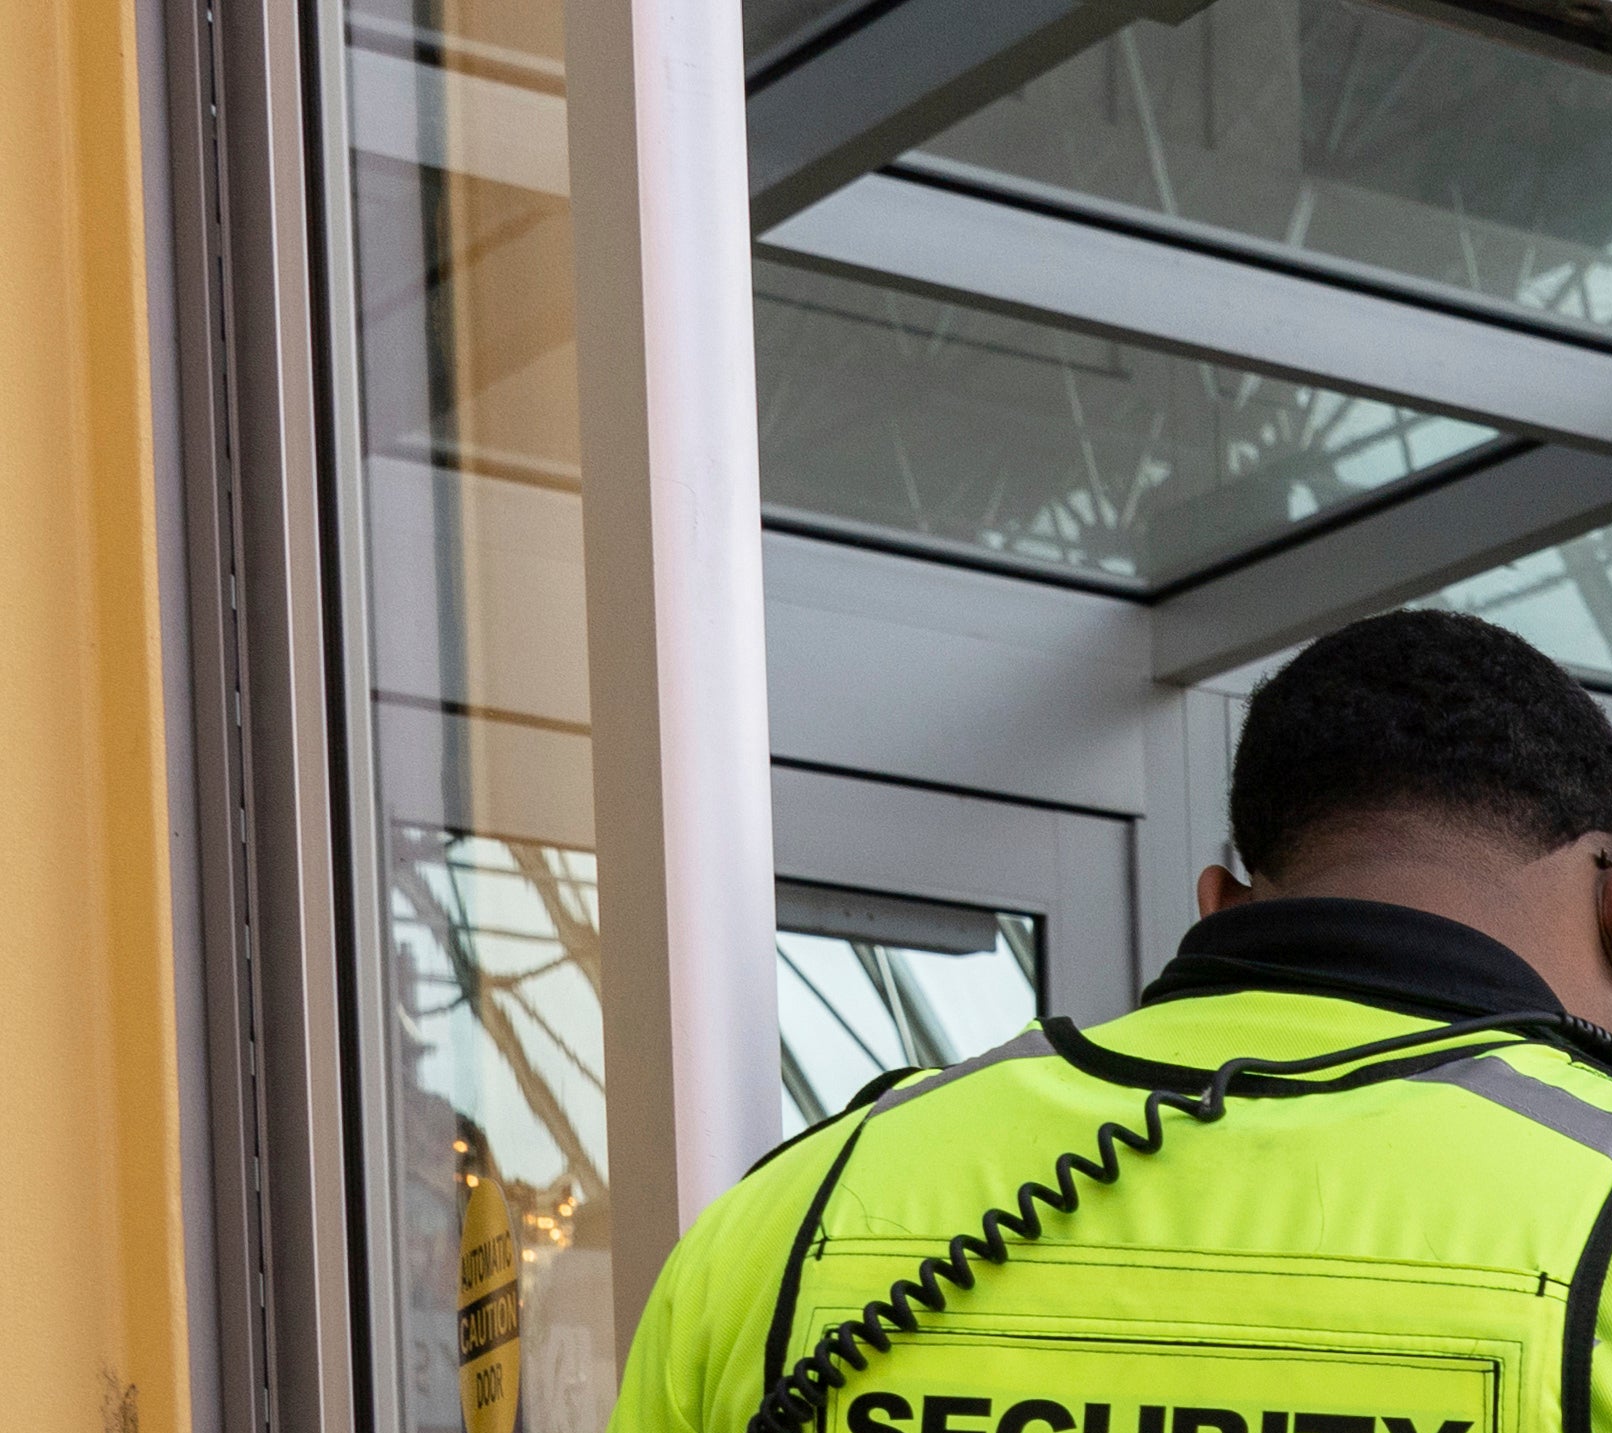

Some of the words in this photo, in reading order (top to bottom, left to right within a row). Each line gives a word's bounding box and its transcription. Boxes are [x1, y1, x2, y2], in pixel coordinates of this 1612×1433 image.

[461, 1229, 513, 1292] AUTOMATIC
[460, 1290, 518, 1354] CAUTION
[475, 1361, 505, 1410] DOOR
